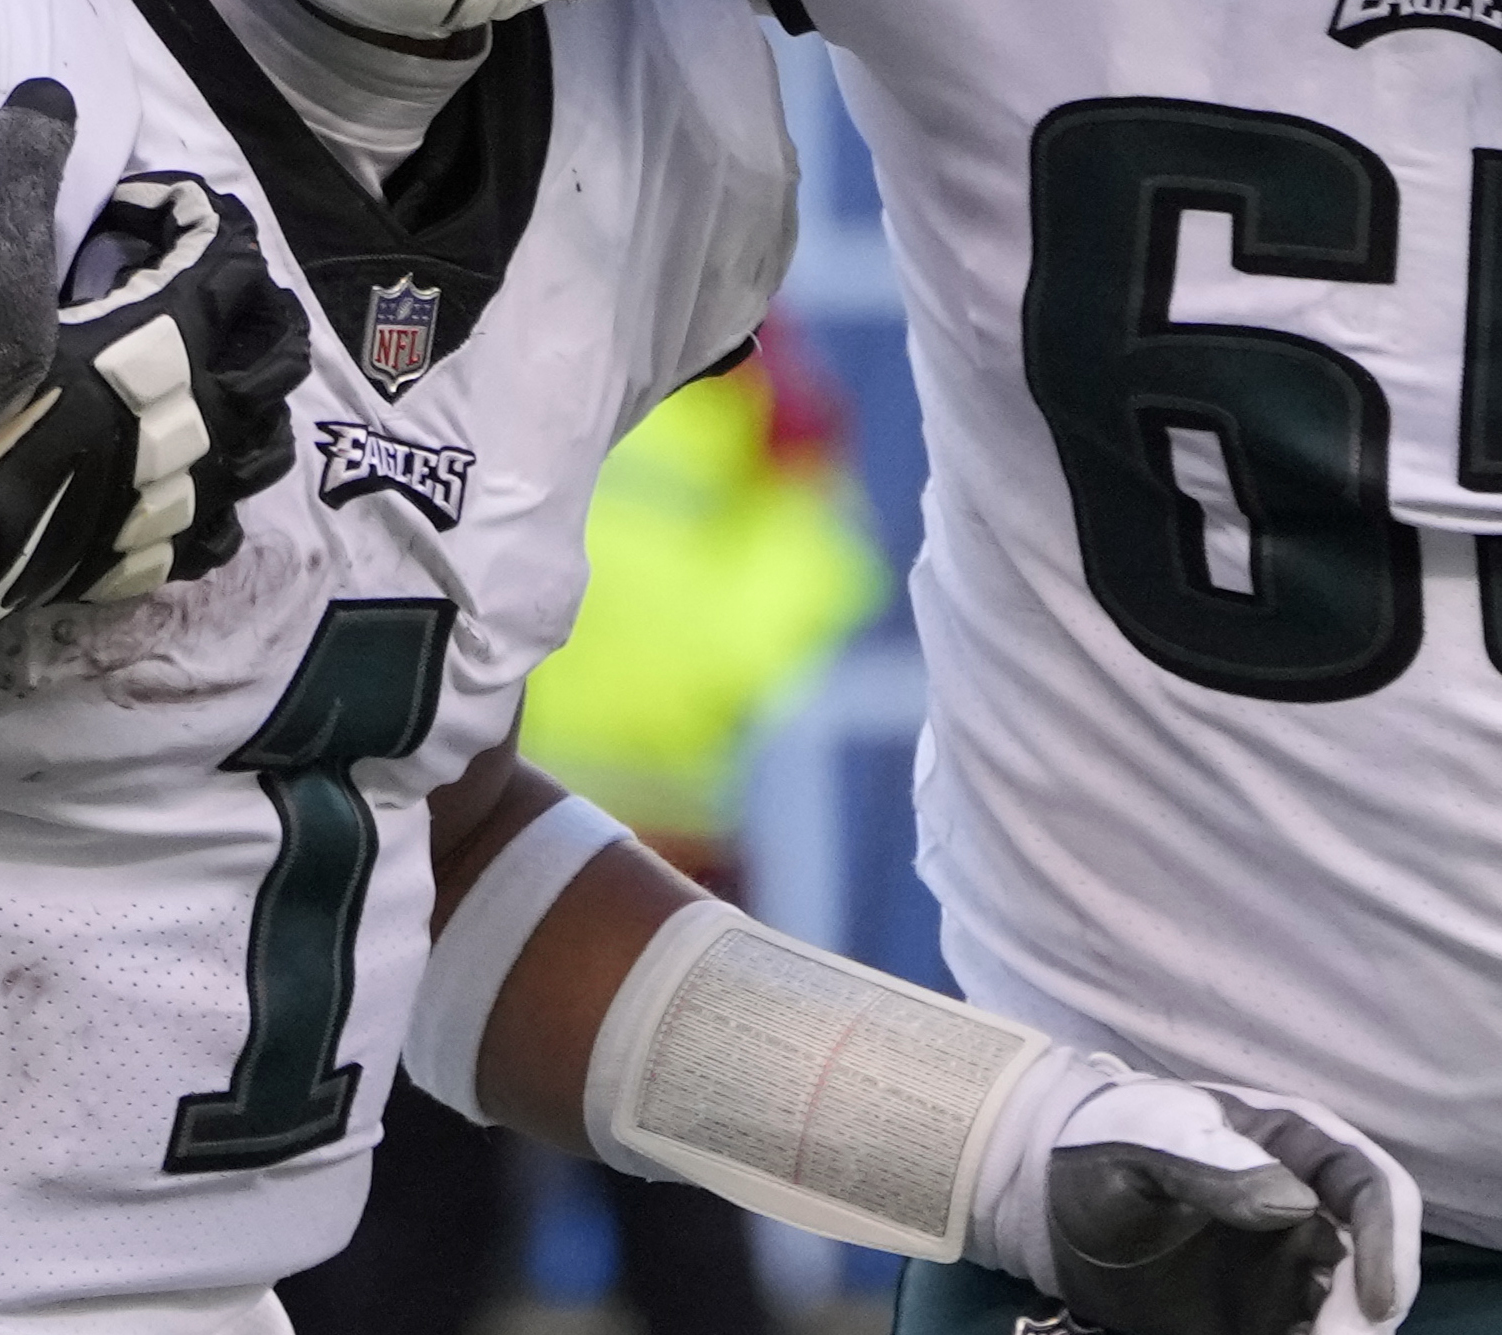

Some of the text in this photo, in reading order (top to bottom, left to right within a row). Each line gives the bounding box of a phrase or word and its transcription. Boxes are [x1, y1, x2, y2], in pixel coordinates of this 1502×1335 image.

[374, 328, 424, 370] NFL
[314, 421, 477, 532] EAGLES
[162, 597, 459, 1172] 1
